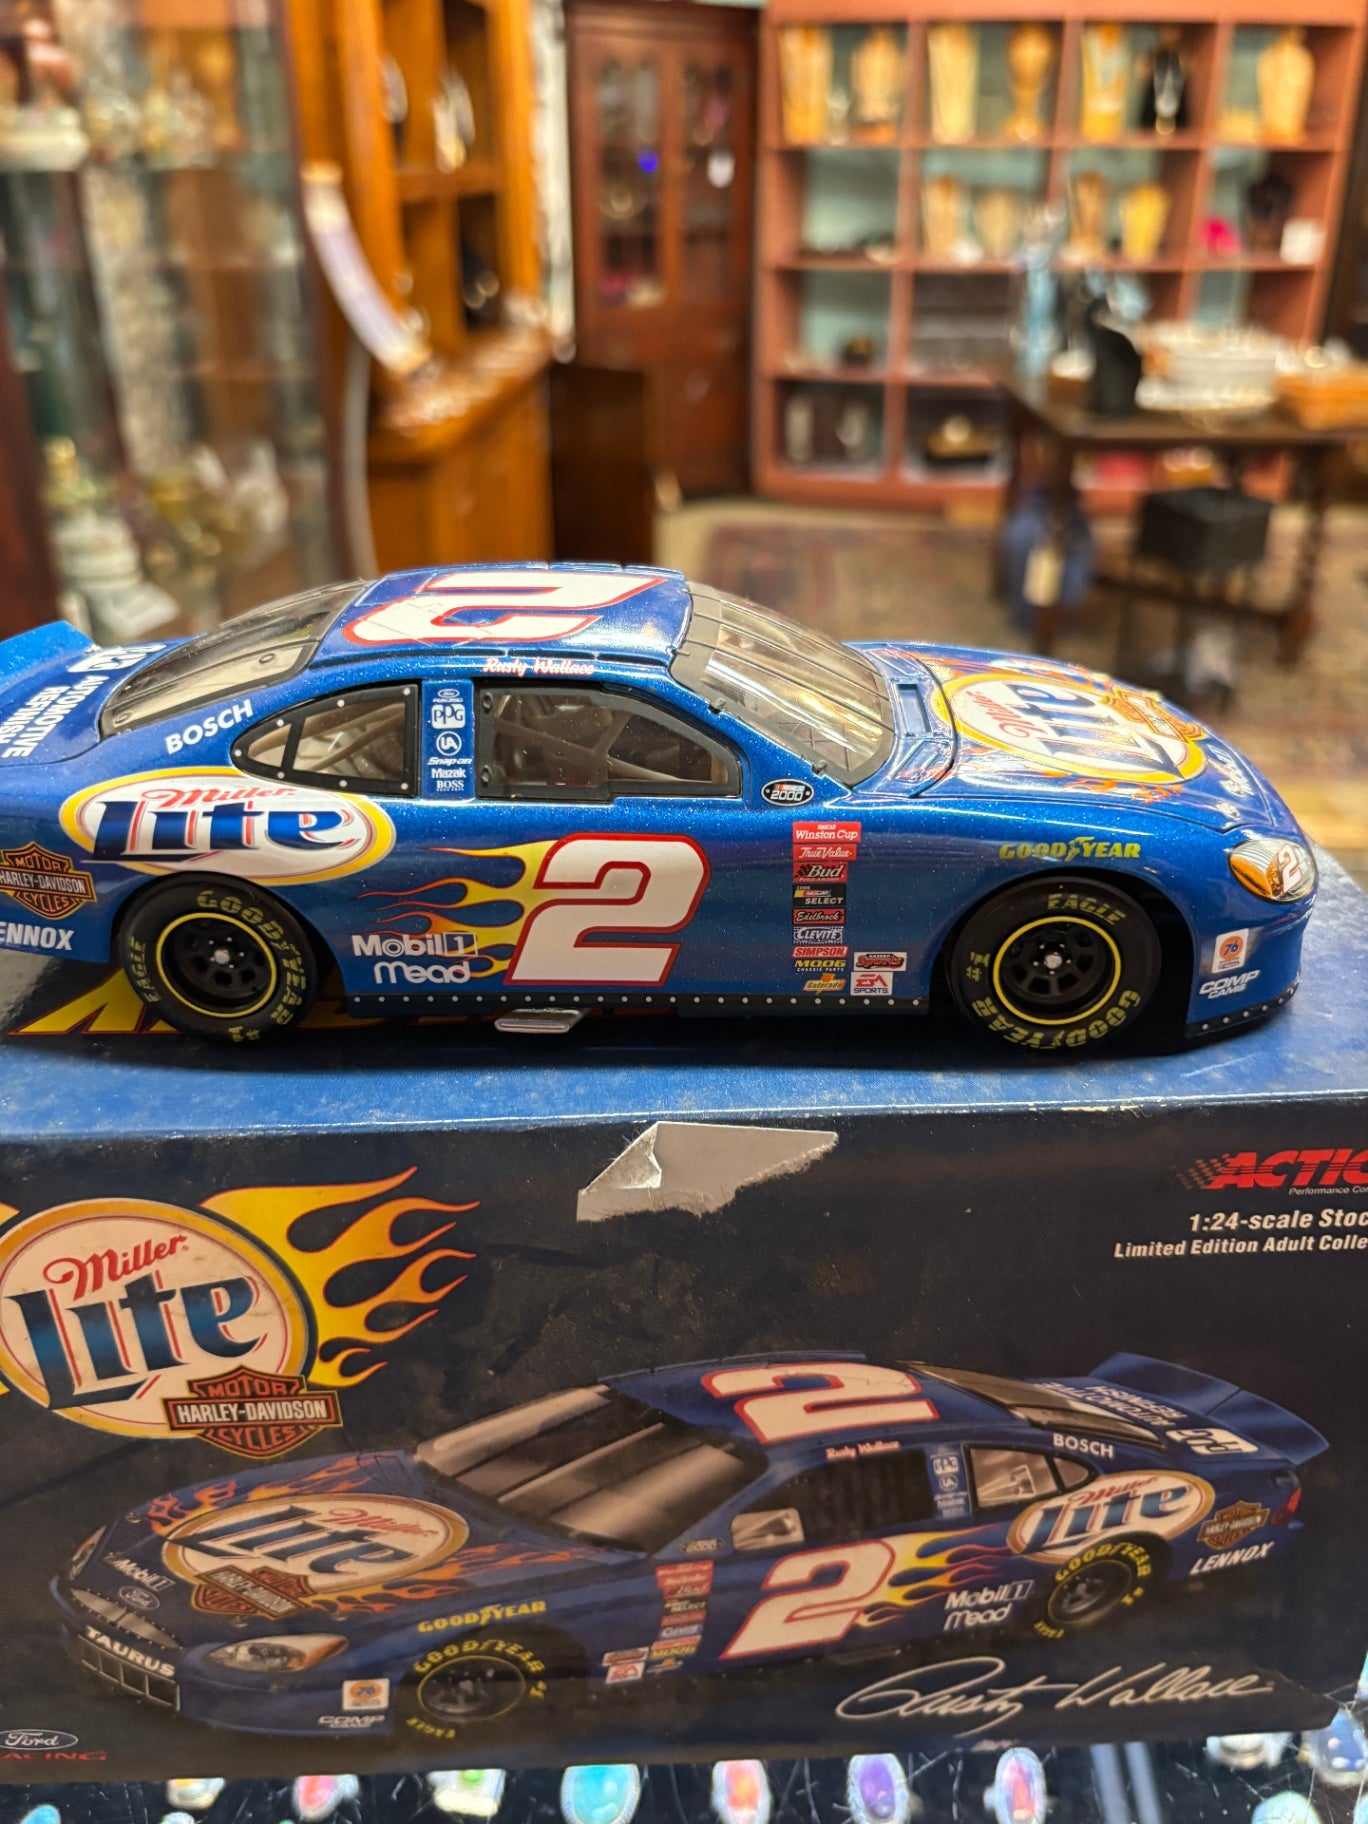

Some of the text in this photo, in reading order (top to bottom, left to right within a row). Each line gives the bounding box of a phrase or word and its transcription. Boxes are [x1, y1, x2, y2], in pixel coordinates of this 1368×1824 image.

[483, 658, 596, 678] Rusty Wallace
[165, 699, 254, 755] BOSCH
[434, 705, 465, 725] PPG
[428, 757, 472, 766] Snap-on
[431, 768, 466, 778] Mazak
[437, 780, 464, 788] BOSS
[770, 791, 803, 801] 2000
[142, 787, 296, 809] Miller
[85, 800, 361, 862] Lite
[796, 830, 858, 840] Winston Cup
[15, 852, 62, 872] MOTOR
[806, 865, 844, 877] Bud
[1277, 843, 1303, 893] 2
[24, 892, 69, 912] CYCLES
[504, 833, 710, 986] 2
[1047, 893, 1126, 925] EAGLE
[351, 933, 445, 957] Mobil
[795, 947, 844, 956] SIMPSON
[1223, 941, 1240, 956] 76
[196, 890, 307, 1025] GOODYEAR
[855, 973, 888, 988] EA
[1199, 969, 1261, 995] COMP
[971, 990, 1141, 1049] GOODYEAR
[1289, 1186, 1350, 1195] Performance
[1189, 1208, 1368, 1232] 1:24-scale Stoc
[1114, 1234, 1368, 1258] Limited Edition Adult Colle
[43, 1234, 190, 1300] Miller
[8, 1272, 268, 1410] Lite
[208, 1375, 287, 1398] MOTOR
[176, 1399, 328, 1424] HARLEY-DAVIDSON
[701, 1360, 940, 1445] 2
[217, 1425, 295, 1450] CYCLES
[1052, 1433, 1115, 1459] BOSCH
[1020, 1484, 1192, 1554] Lite
[1189, 1541, 1275, 1575] LENNOX
[718, 1540, 896, 1661] 2
[944, 1584, 1010, 1610] Mobil
[417, 1600, 547, 1632] GOODYEAR
[86, 1627, 175, 1677] TAURUS
[5, 1731, 60, 1746] Ford
